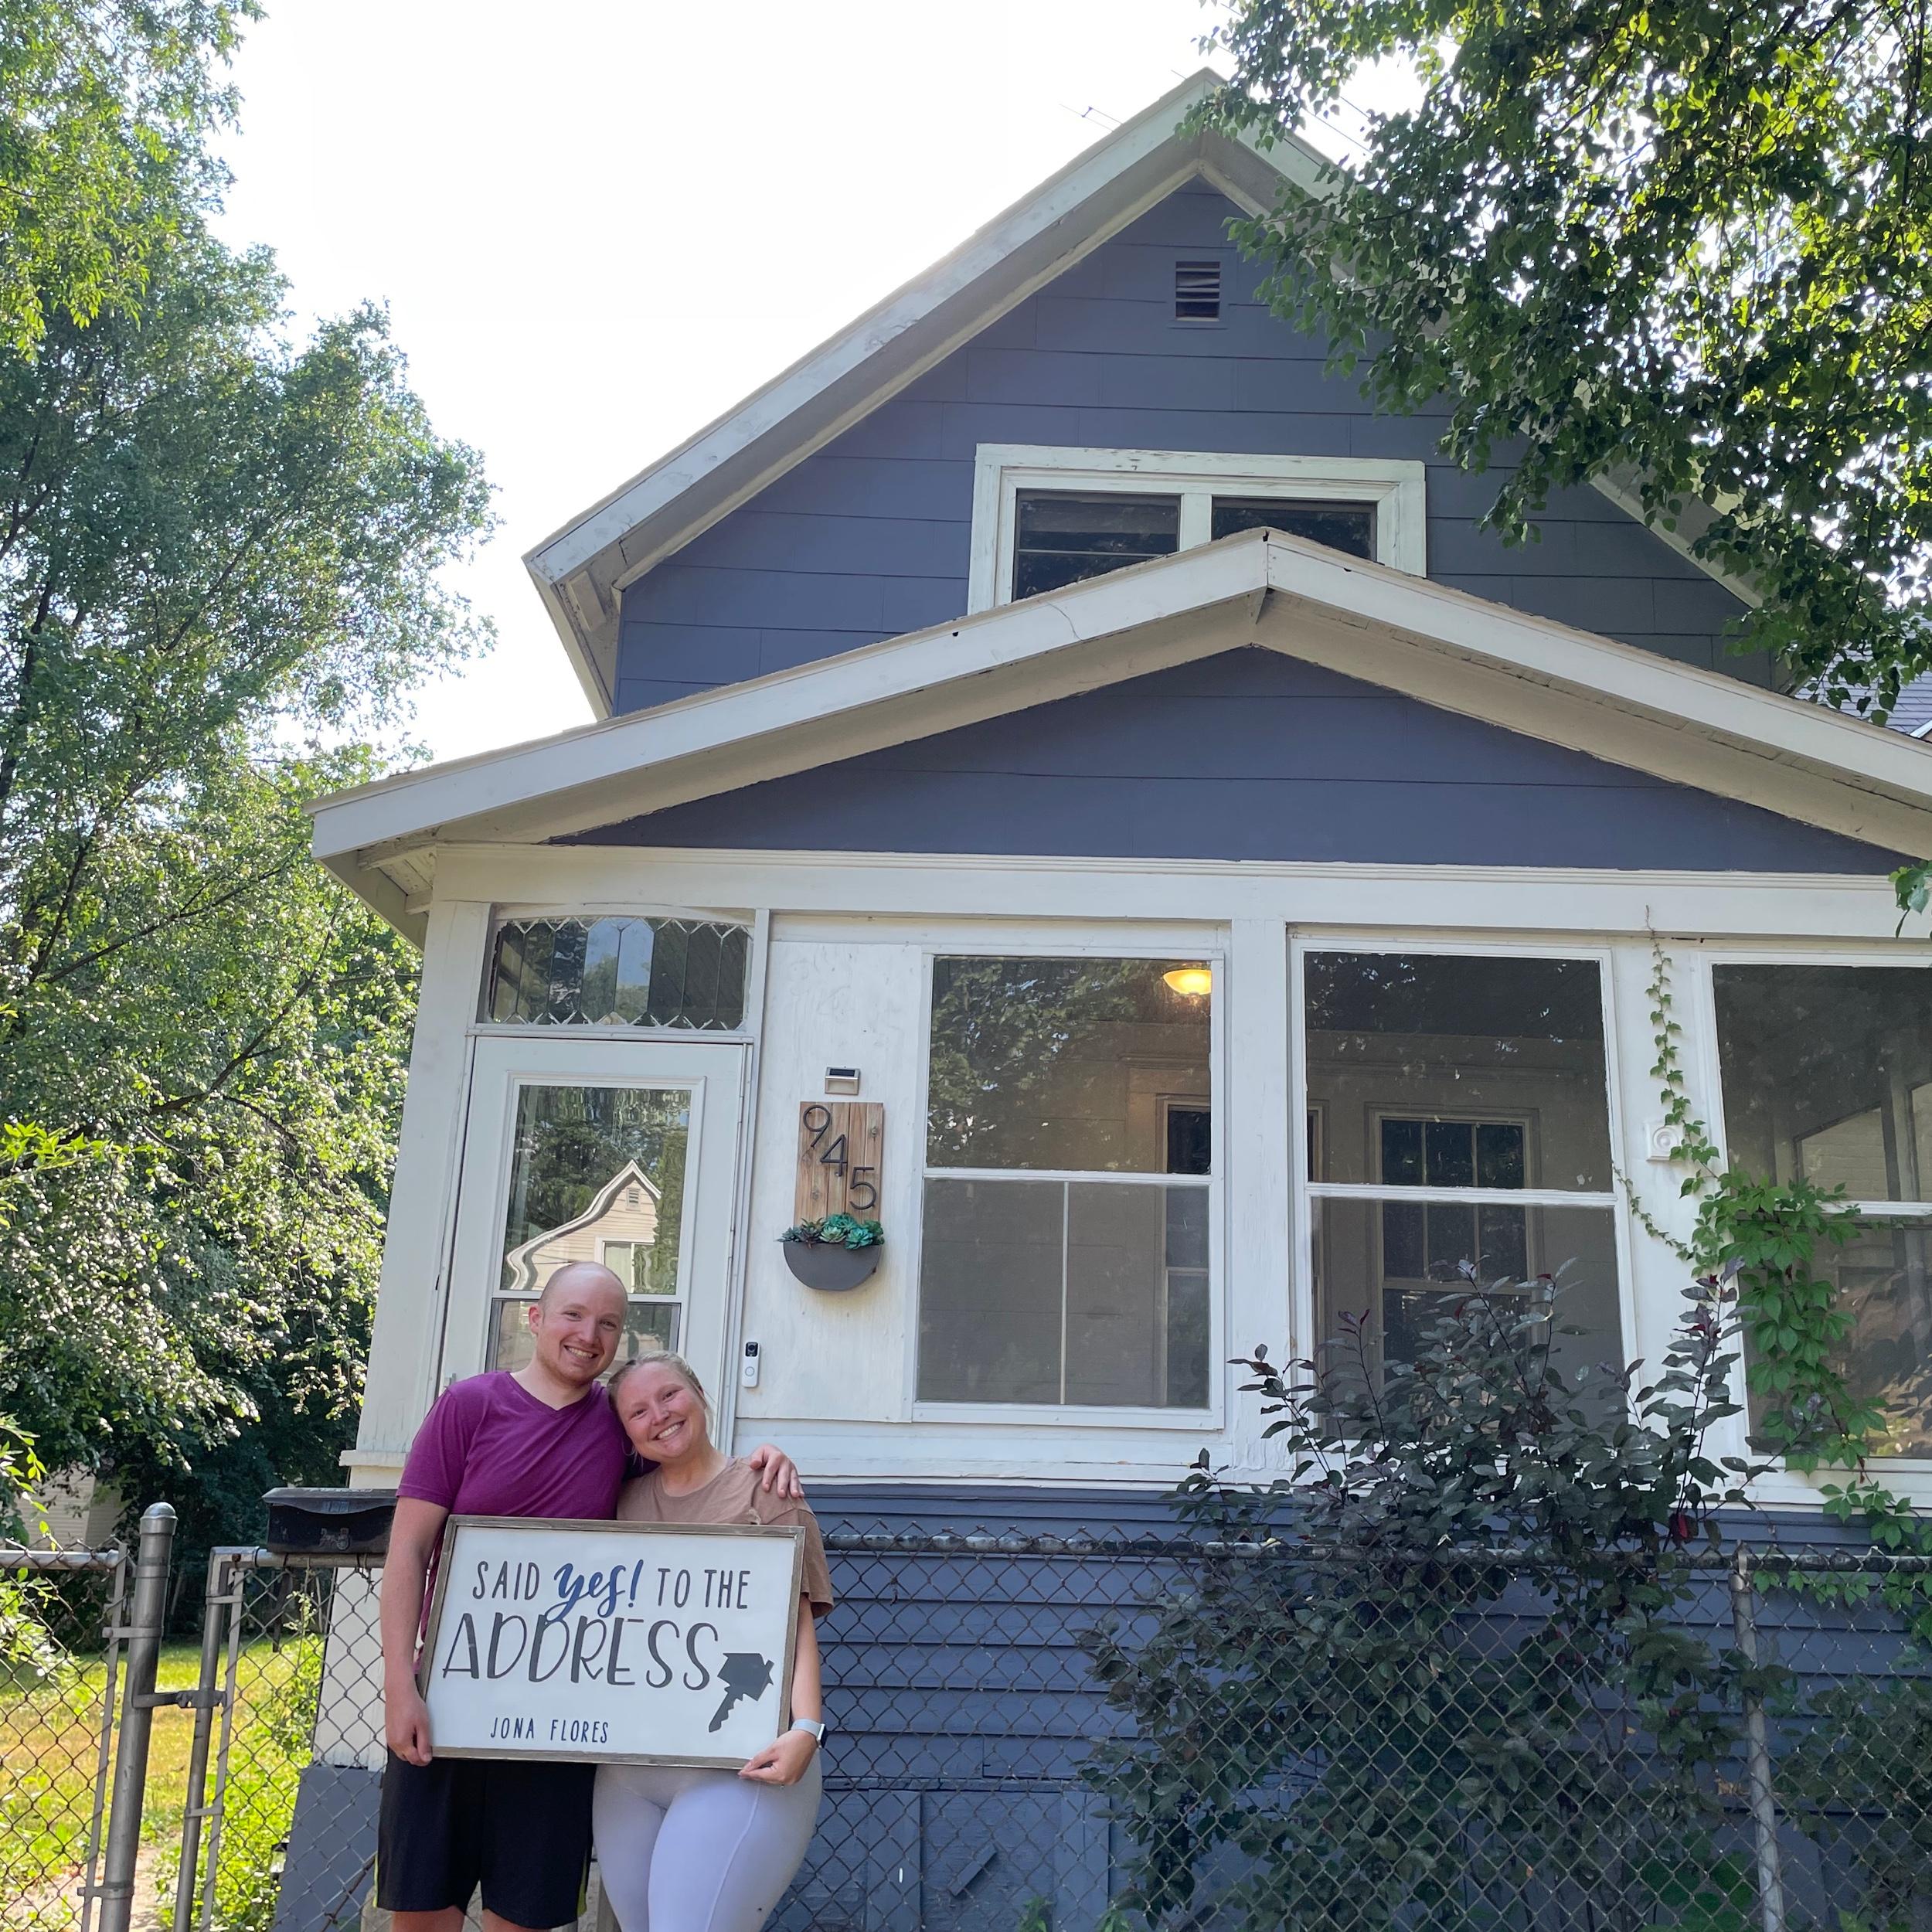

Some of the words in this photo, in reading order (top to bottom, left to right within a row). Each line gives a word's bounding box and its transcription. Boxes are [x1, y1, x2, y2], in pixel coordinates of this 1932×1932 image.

[803, 1105, 876, 1210] 945
[472, 1561, 539, 1600] SAID
[546, 1560, 645, 1620] yes!
[658, 1568, 691, 1609] TO
[704, 1569, 751, 1609] THE
[442, 1612, 719, 1691] ADDRESS
[491, 1717, 535, 1740] JONA
[550, 1719, 609, 1744] FLORES
